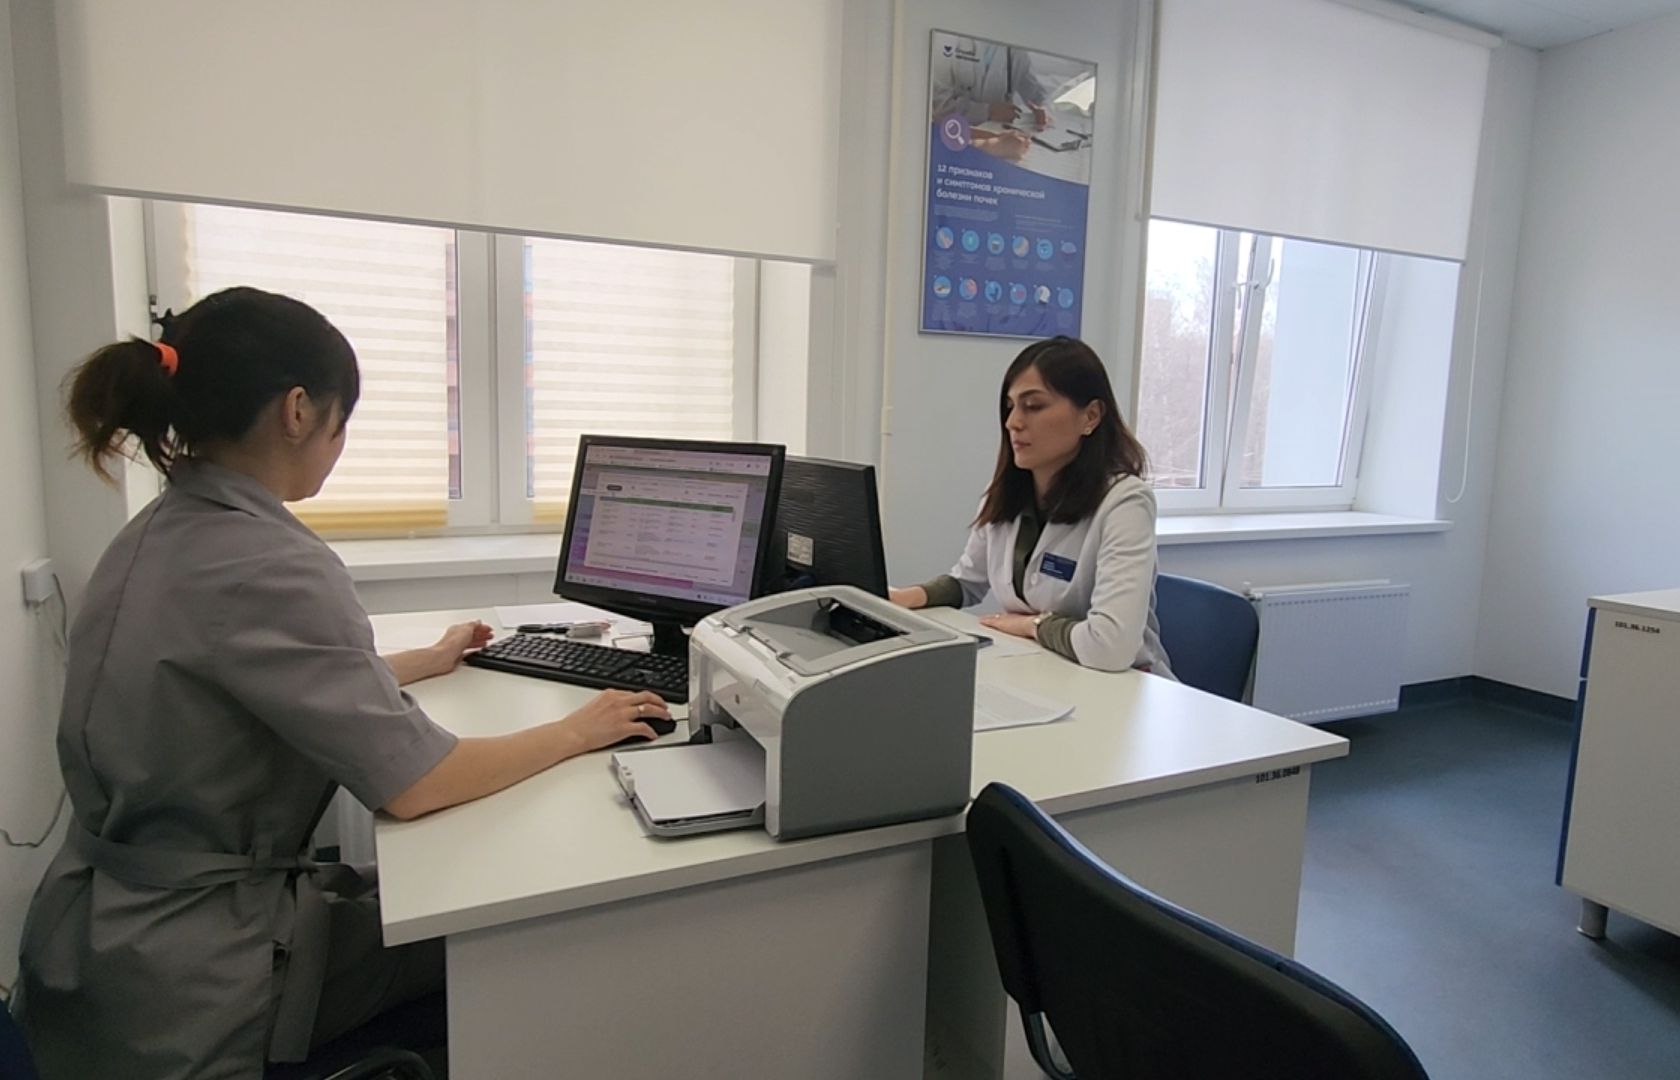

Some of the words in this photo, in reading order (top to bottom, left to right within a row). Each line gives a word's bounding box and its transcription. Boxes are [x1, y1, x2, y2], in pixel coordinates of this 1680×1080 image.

[937, 164, 947, 173] 12
[949, 165, 993, 179] признаков
[936, 188, 971, 201] болезни
[974, 194, 998, 205] почек
[944, 179, 991, 192] симптомов
[993, 186, 1045, 199] хронической
